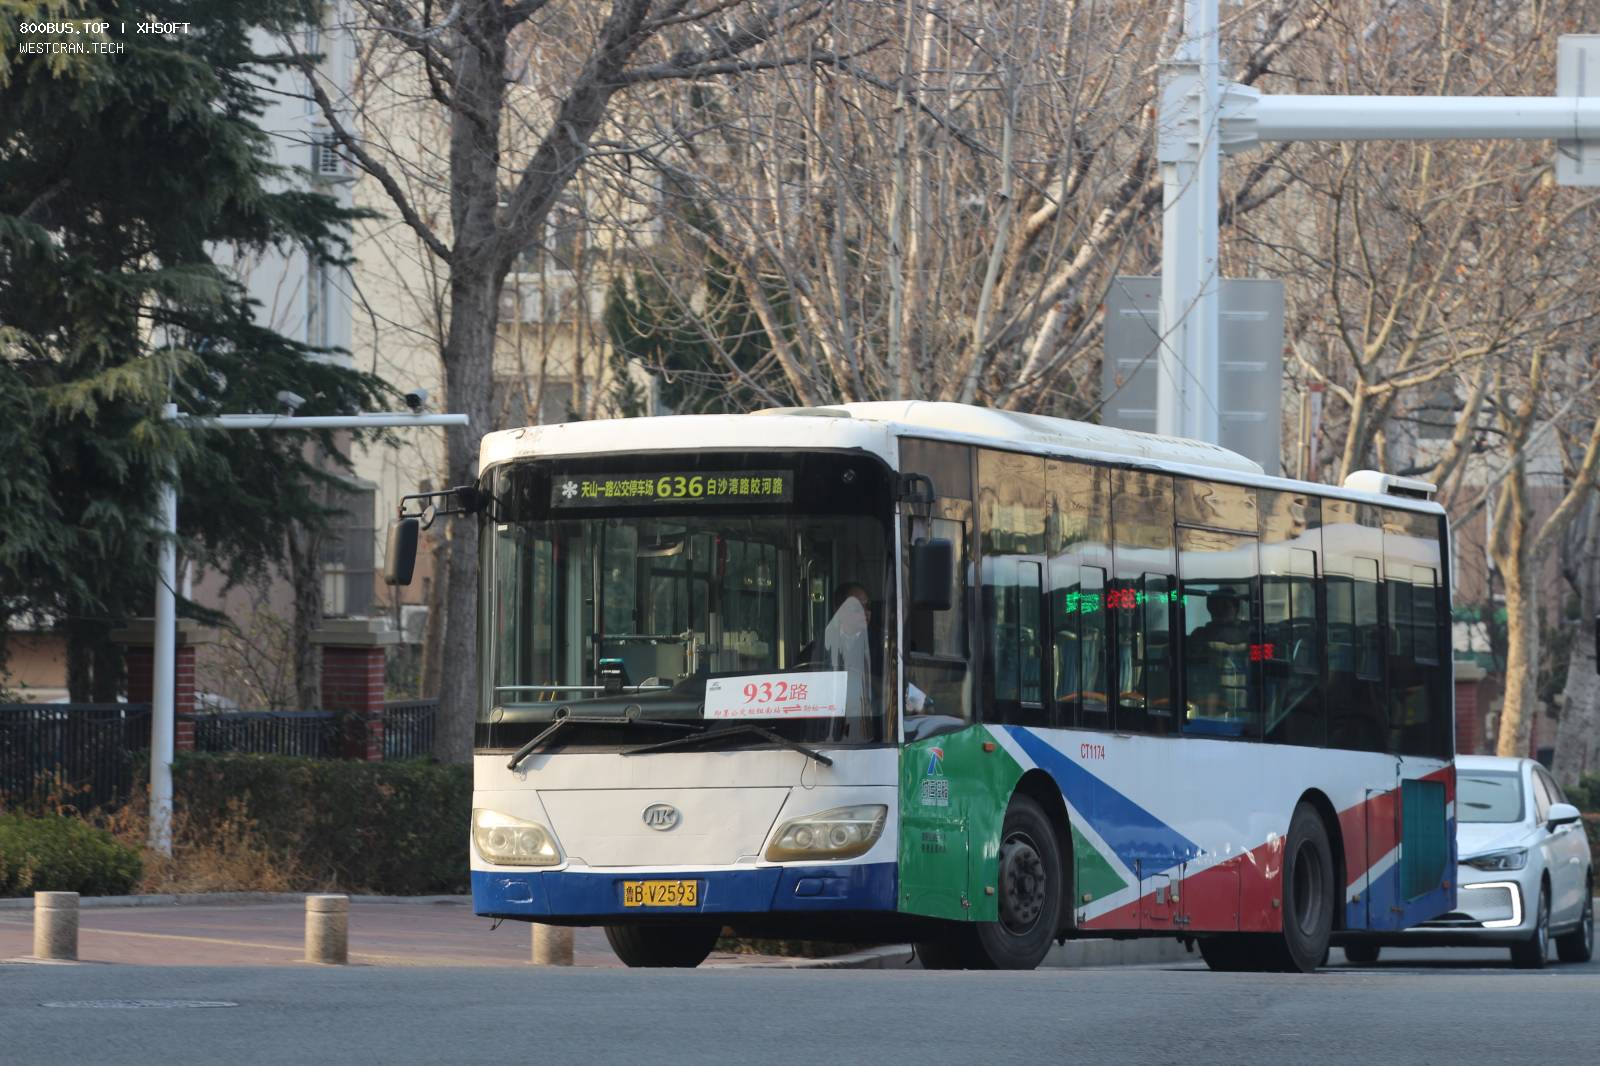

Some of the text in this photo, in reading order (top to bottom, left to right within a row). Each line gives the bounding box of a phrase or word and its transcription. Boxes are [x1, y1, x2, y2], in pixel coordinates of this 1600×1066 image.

[581, 480, 654, 498] 天山一路公交停车场
[656, 476, 704, 498] 636
[743, 681, 808, 704] 932路
[1080, 743, 1105, 760] CT1174
